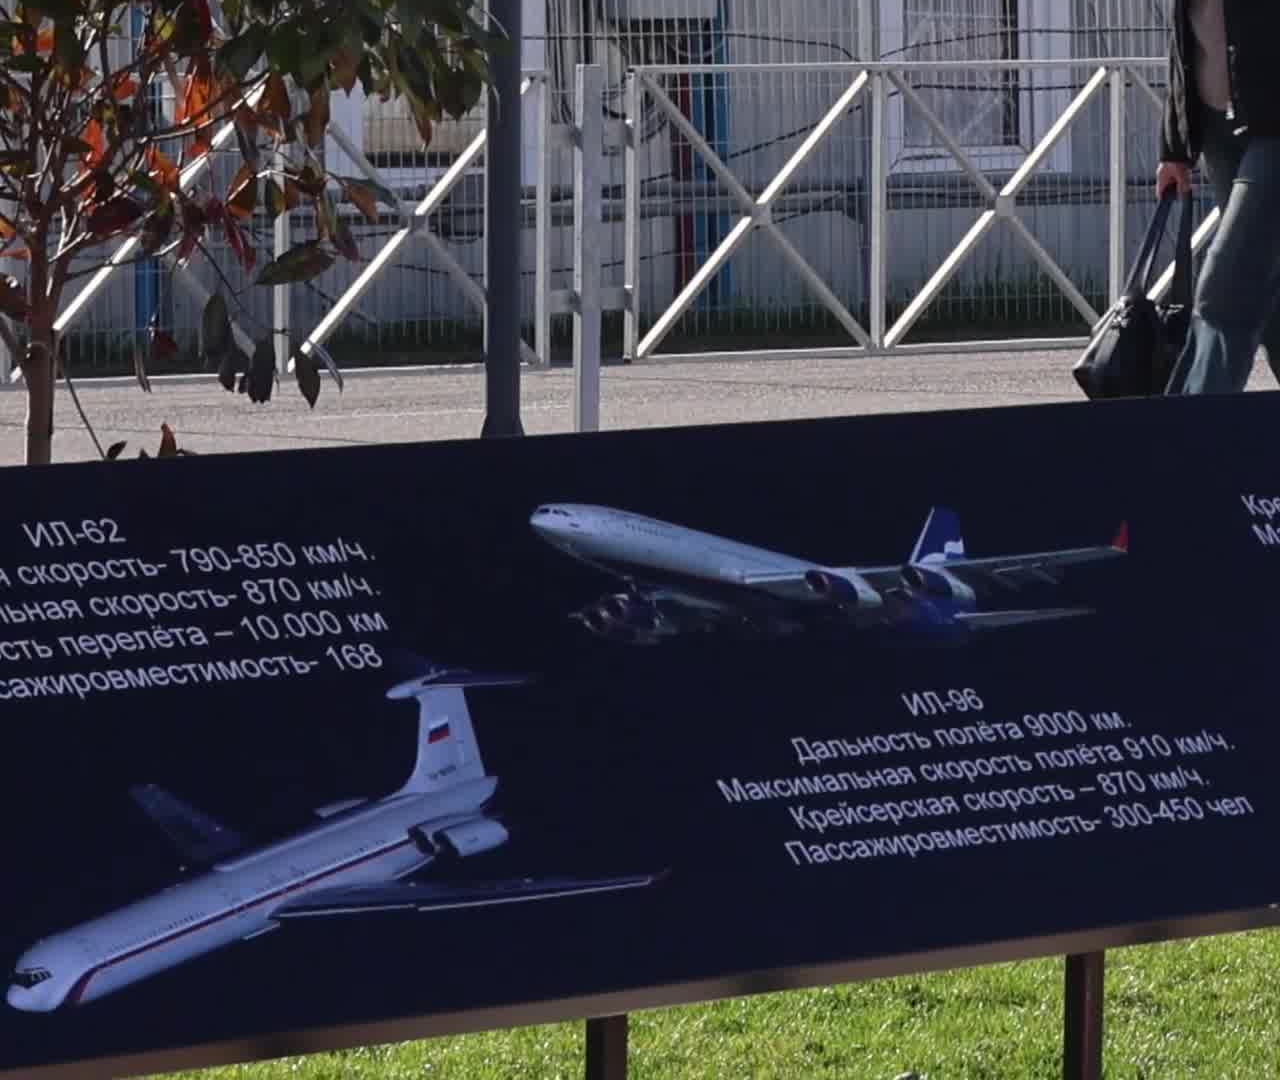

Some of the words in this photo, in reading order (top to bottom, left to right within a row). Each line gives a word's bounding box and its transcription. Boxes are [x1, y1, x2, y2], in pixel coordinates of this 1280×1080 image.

[22, 518, 126, 548] ИЛ-62
[17, 558, 167, 588] скорость-
[169, 542, 296, 573] 790-850
[301, 537, 375, 565] км/ч.
[89, 589, 237, 619] скорость-
[242, 577, 301, 605] 870
[306, 572, 381, 600] км/ч.
[58, 624, 208, 659] перелёта
[240, 610, 342, 640] 10.000
[347, 612, 389, 632] км
[326, 643, 382, 670] 168
[901, 688, 984, 716] ИЛ-96
[790, 732, 932, 766] Дальность
[933, 720, 1024, 747] полёта
[1023, 710, 1087, 736] 9000
[1090, 712, 1132, 730] км.
[716, 766, 917, 803] Максимальная
[920, 754, 1032, 783] скорость
[1034, 744, 1124, 768] полёта
[1122, 734, 1172, 760] 910
[1174, 730, 1235, 755] км/ч.
[788, 796, 960, 834] Крейсерская
[963, 784, 1075, 812] скорость
[1096, 770, 1146, 796] 870
[1148, 765, 1210, 790] км/ч.
[784, 816, 1102, 865] Пассажировместимость-
[1104, 796, 1204, 829] 300-450
[1206, 796, 1254, 816] чел
